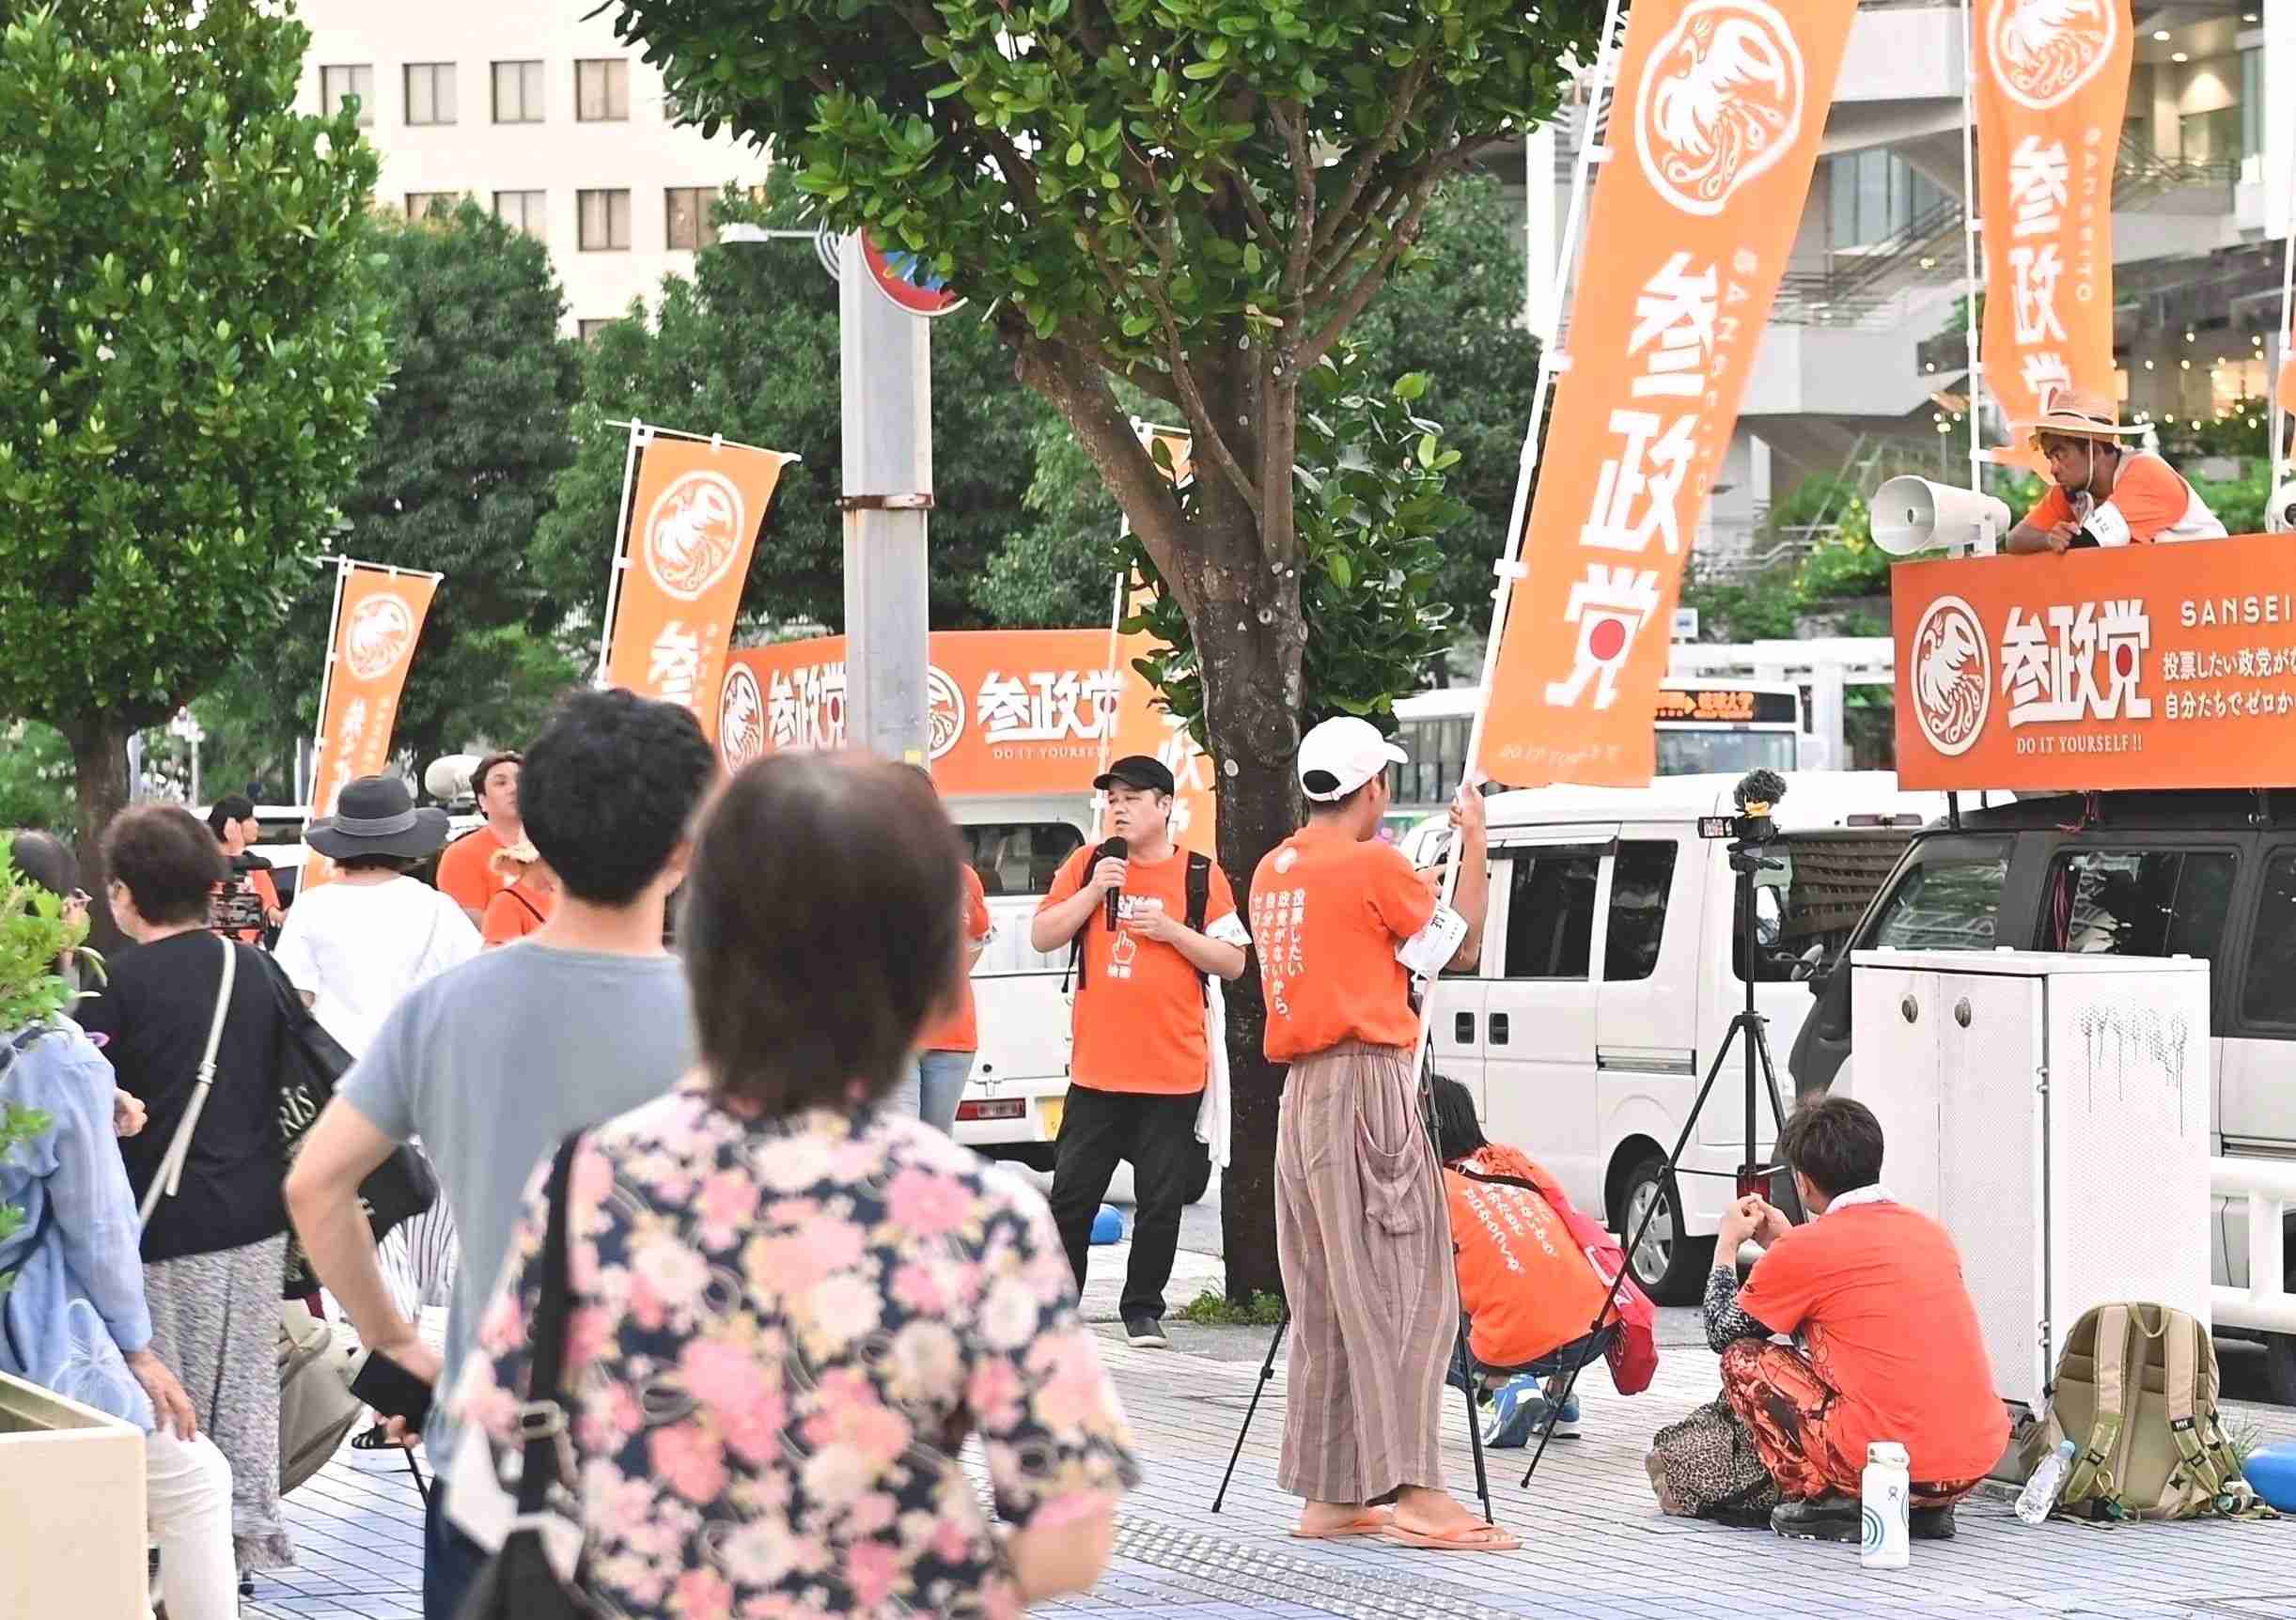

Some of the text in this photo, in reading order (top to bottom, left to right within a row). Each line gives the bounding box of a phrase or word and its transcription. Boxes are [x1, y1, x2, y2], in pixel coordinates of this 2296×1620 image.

[1545, 251, 1718, 710] 参政党
[2180, 594, 2291, 628] SANSEI
[2001, 598, 2153, 728] 参政党
[977, 669, 1121, 744] 参政党
[2165, 687, 2295, 721] 自分たちでゼロか
[2017, 737, 2036, 754] DO
[2040, 737, 2054, 754] IT
[2058, 735, 2129, 753] YOURSELF
